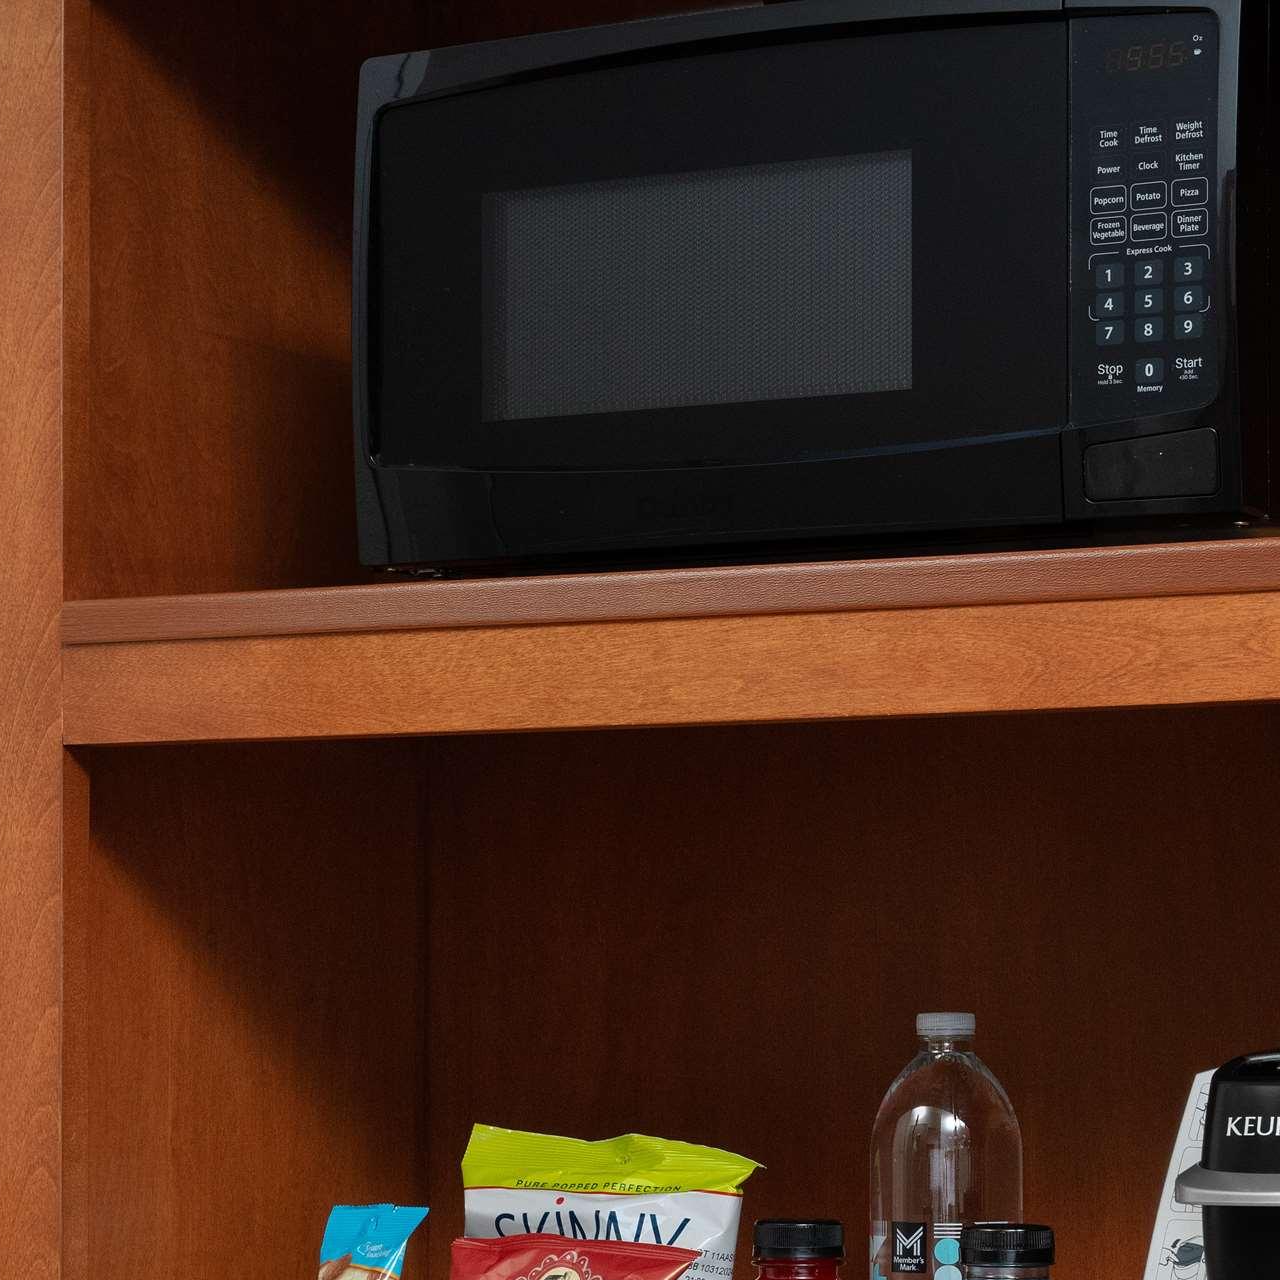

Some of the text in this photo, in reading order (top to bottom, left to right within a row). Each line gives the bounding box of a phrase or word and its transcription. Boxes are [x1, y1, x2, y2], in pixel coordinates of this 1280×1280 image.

[1139, 126, 1158, 134] Time
[1175, 120, 1203, 131] Weight
[1100, 130, 1118, 139] Time
[1134, 134, 1162, 144] Defrost
[1175, 130, 1204, 140] Defrost
[1099, 138, 1119, 148] Cook
[1175, 152, 1204, 162] Kitchen
[1097, 165, 1121, 175] Power
[1138, 161, 1159, 171] Clock
[1178, 162, 1200, 171] Timer
[1136, 192, 1161, 201] Potato
[1180, 188, 1199, 197] Pizza
[1094, 196, 1124, 206] Popcorn
[1177, 215, 1202, 224] Dinner
[1097, 221, 1121, 229] Frozen
[1133, 222, 1165, 232] Beverage
[1179, 223, 1200, 233] Plate
[1092, 229, 1125, 240] Vegetable
[1126, 244, 1172, 256] Express Cook
[1143, 265, 1153, 279] 2
[1183, 262, 1193, 275] 3
[1104, 269, 1112, 282] 1
[1143, 294, 1153, 308] 5
[1183, 291, 1193, 304] 6
[1104, 297, 1114, 311] 4
[1143, 323, 1153, 336] 8
[1183, 319, 1193, 333] 9
[1104, 326, 1113, 339] 7
[1175, 356, 1203, 369] Start
[1097, 363, 1124, 376] Stop
[1144, 363, 1154, 377] 0
[1137, 384, 1163, 393] Memory
[516, 1179, 682, 1193] PURE POPPED PERFECTION
[893, 1256, 925, 1264] Member's
[899, 1263, 917, 1271] Mark
